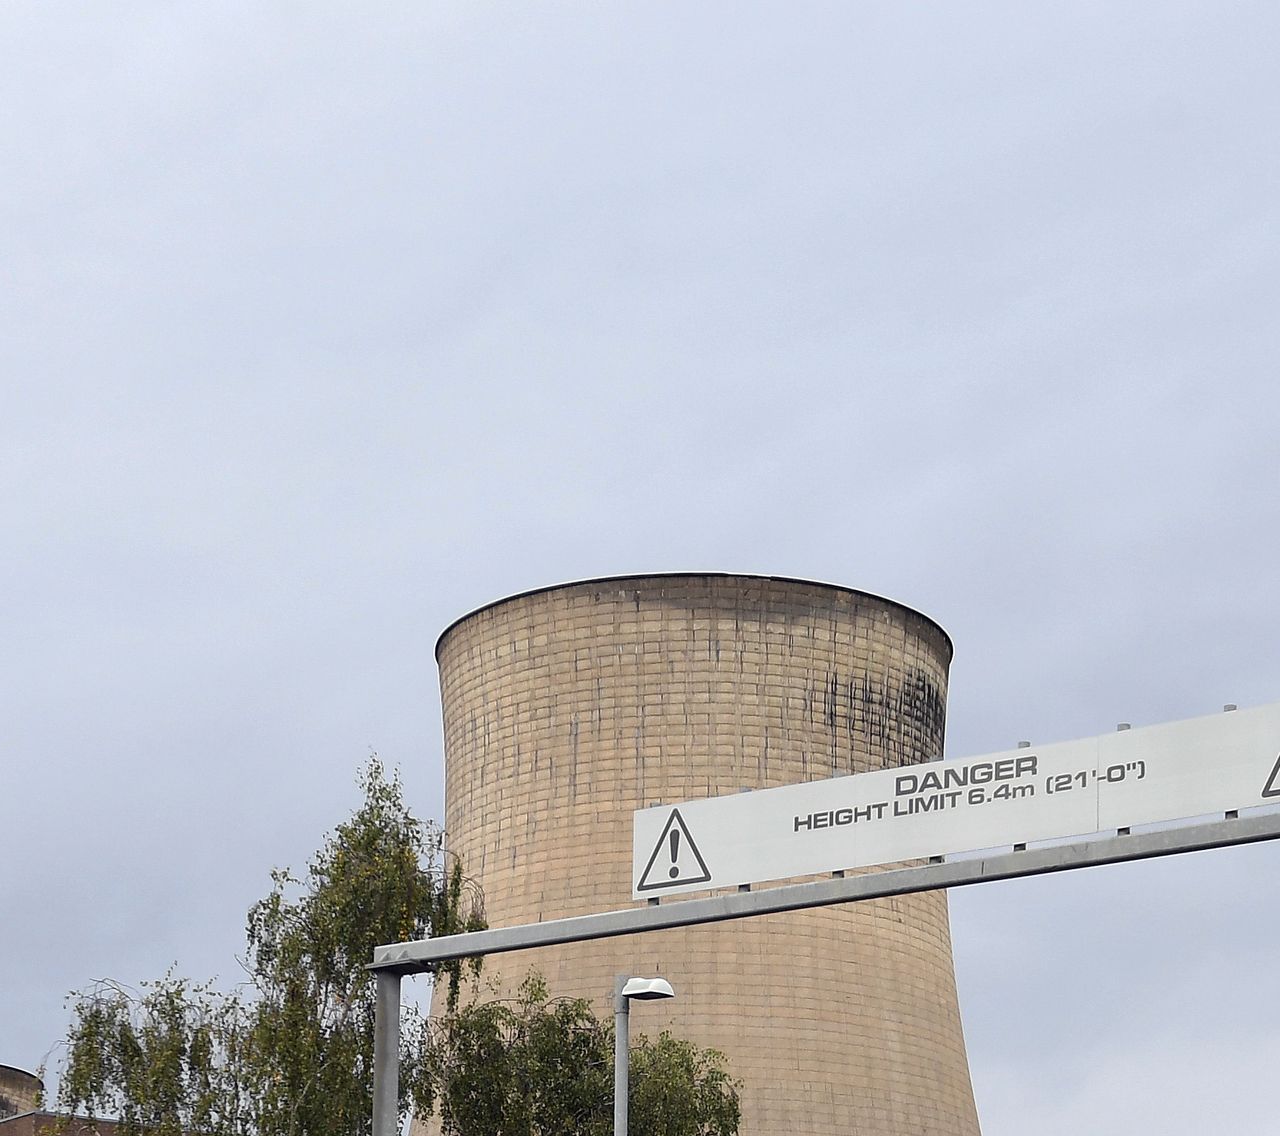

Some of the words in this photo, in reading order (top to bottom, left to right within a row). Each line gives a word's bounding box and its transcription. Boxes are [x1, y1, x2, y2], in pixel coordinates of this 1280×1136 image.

[895, 754, 1038, 797] DANGER
[793, 802, 888, 832] HEIGHT
[893, 792, 964, 818] LIMIT
[967, 782, 1036, 808] 6.4m
